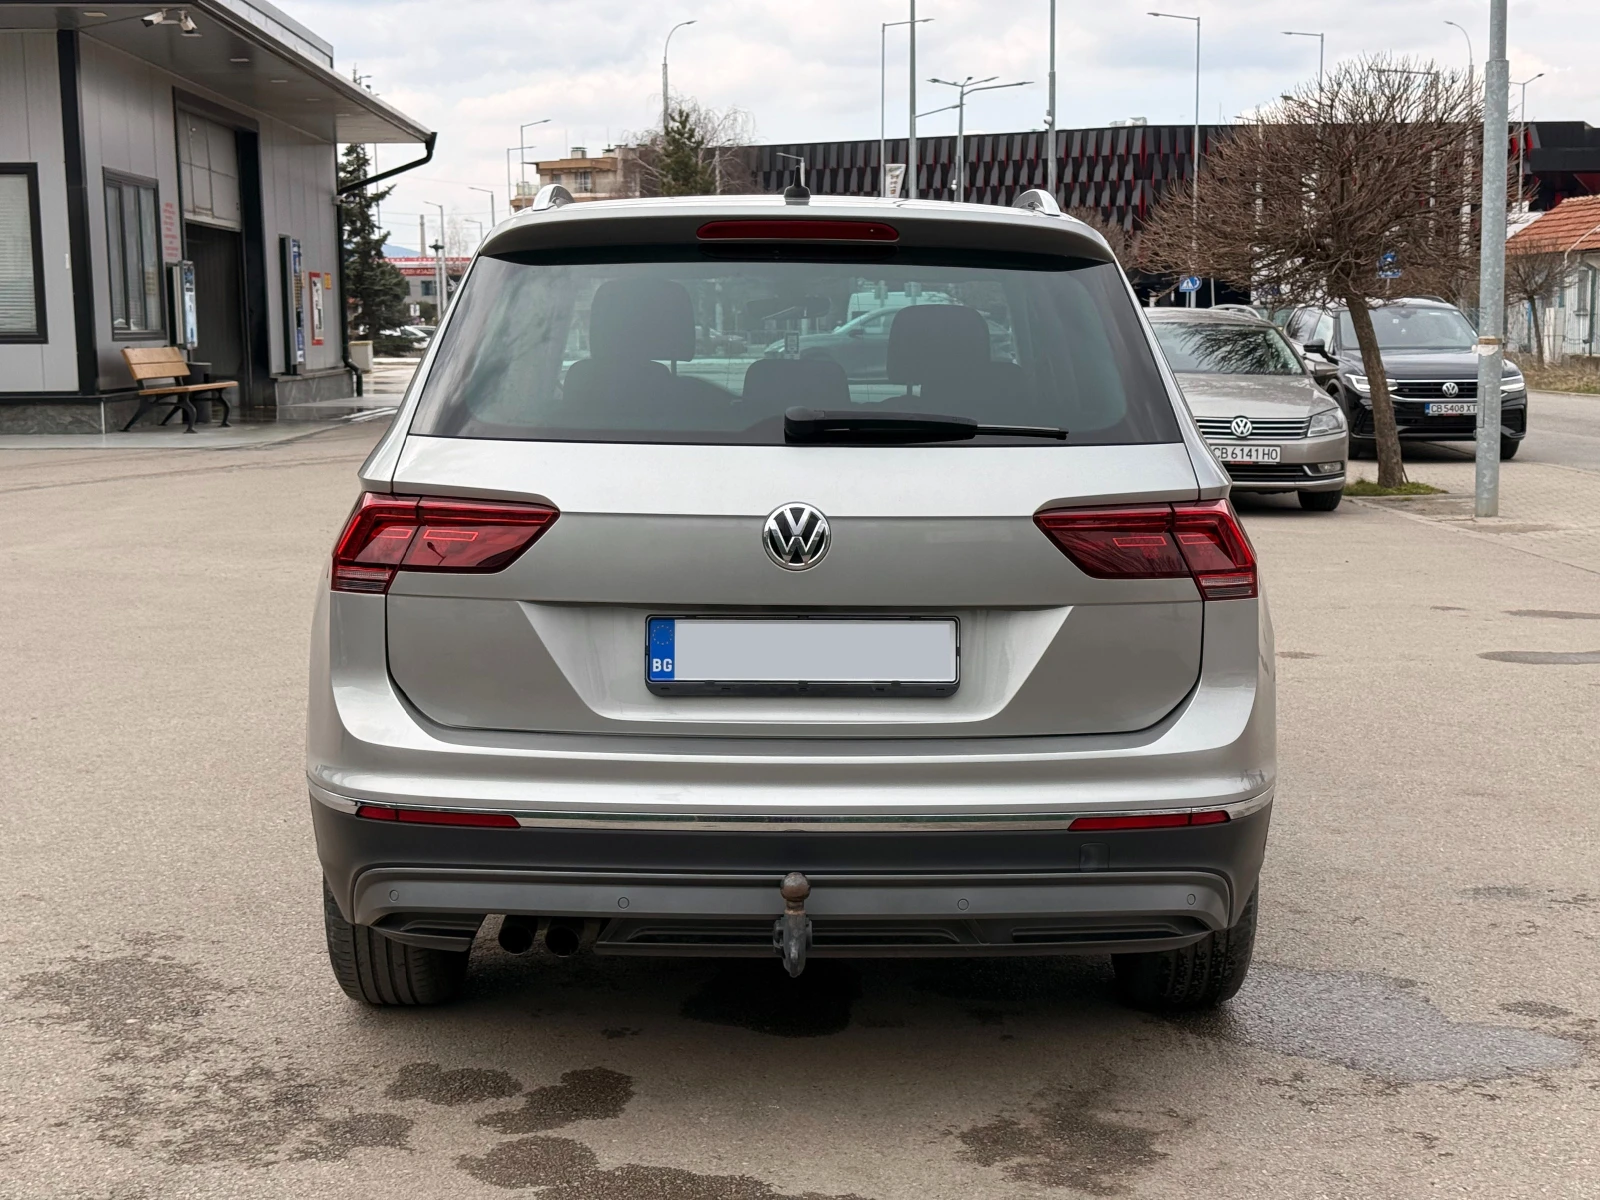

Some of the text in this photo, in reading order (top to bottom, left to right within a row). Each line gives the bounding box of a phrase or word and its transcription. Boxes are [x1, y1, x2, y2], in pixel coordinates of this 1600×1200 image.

[1231, 417, 1252, 437] VW
[1230, 447, 1260, 460] 6141
[1262, 448, 1279, 461] HO
[763, 503, 831, 571] VW
[652, 658, 673, 672] BG
